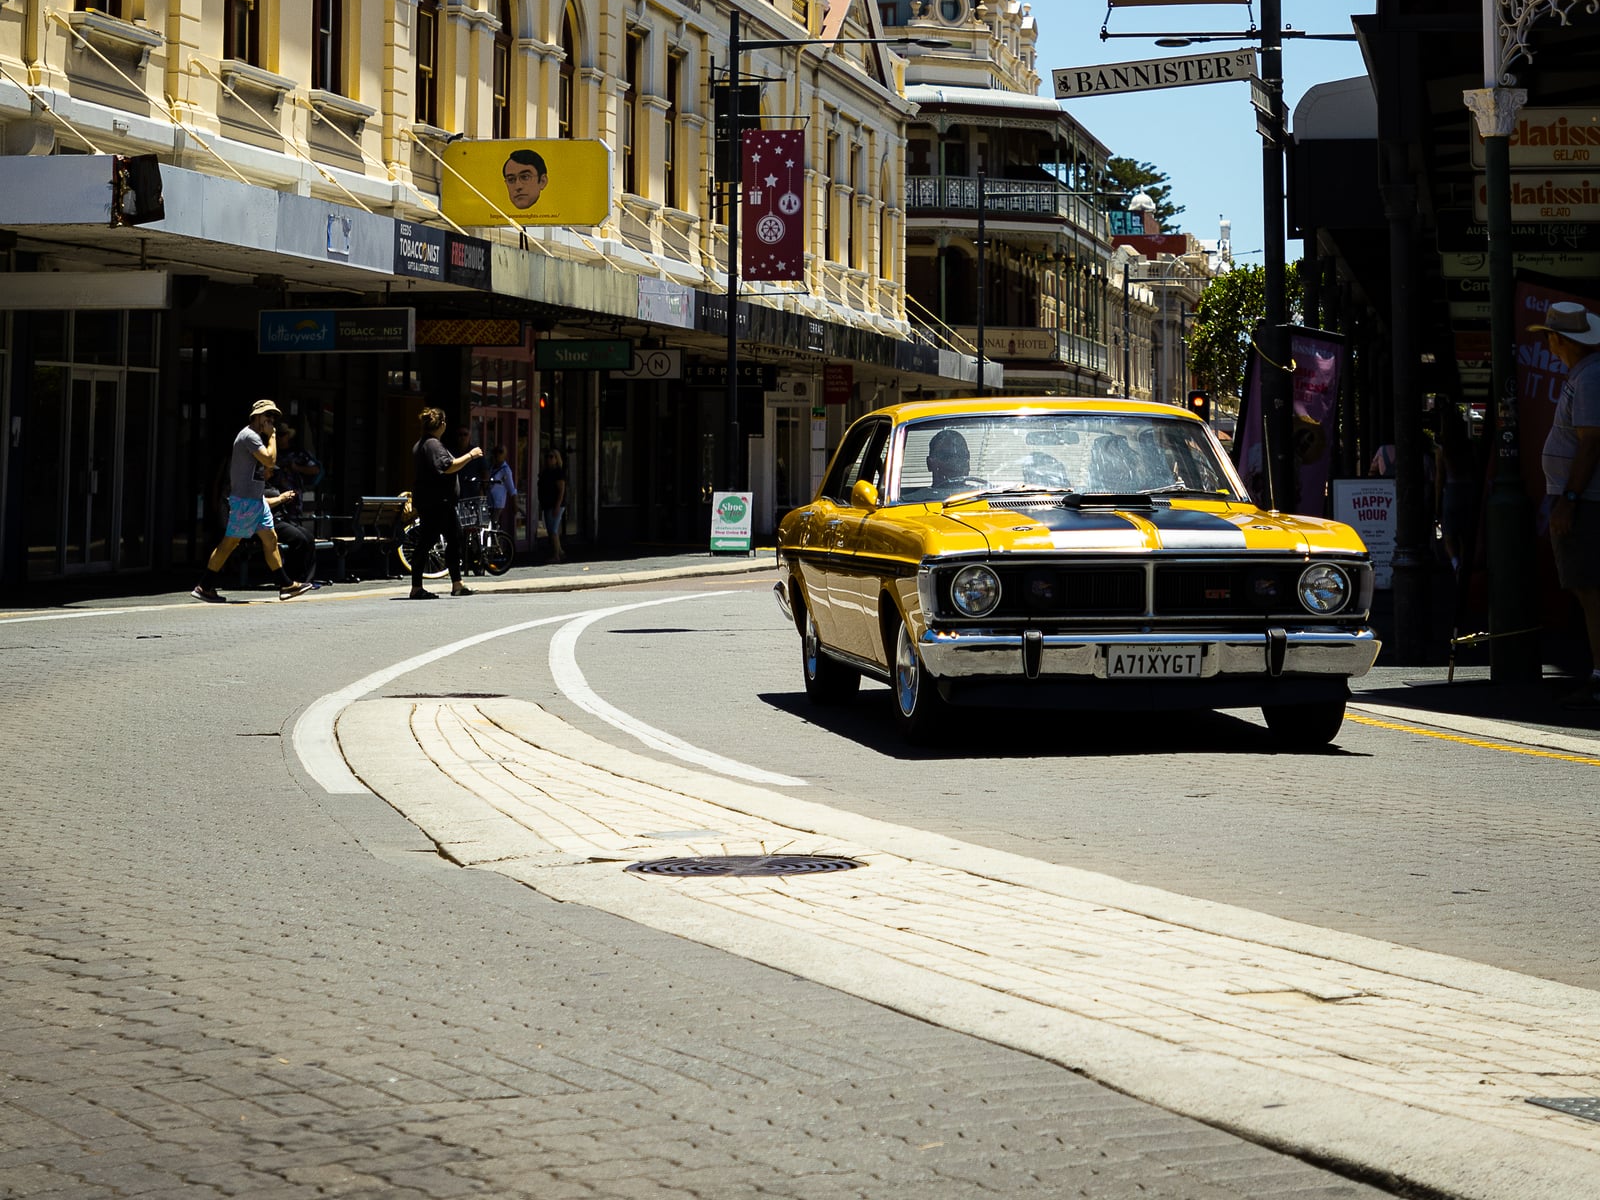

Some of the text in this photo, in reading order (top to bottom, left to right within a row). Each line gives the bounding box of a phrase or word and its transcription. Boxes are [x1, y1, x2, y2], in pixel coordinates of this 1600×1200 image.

[1074, 53, 1253, 93] BANNISTER ST
[1553, 150, 1590, 161] GELATO
[1540, 207, 1571, 217] GELATO
[267, 321, 329, 345] lotterywest
[1018, 339, 1048, 349] HOTEL
[555, 347, 588, 361] Shoe
[722, 502, 743, 511] Shoe
[1352, 495, 1393, 509] HAPPY
[1358, 508, 1387, 521] HOUR
[1113, 654, 1196, 674] A71XYGT
